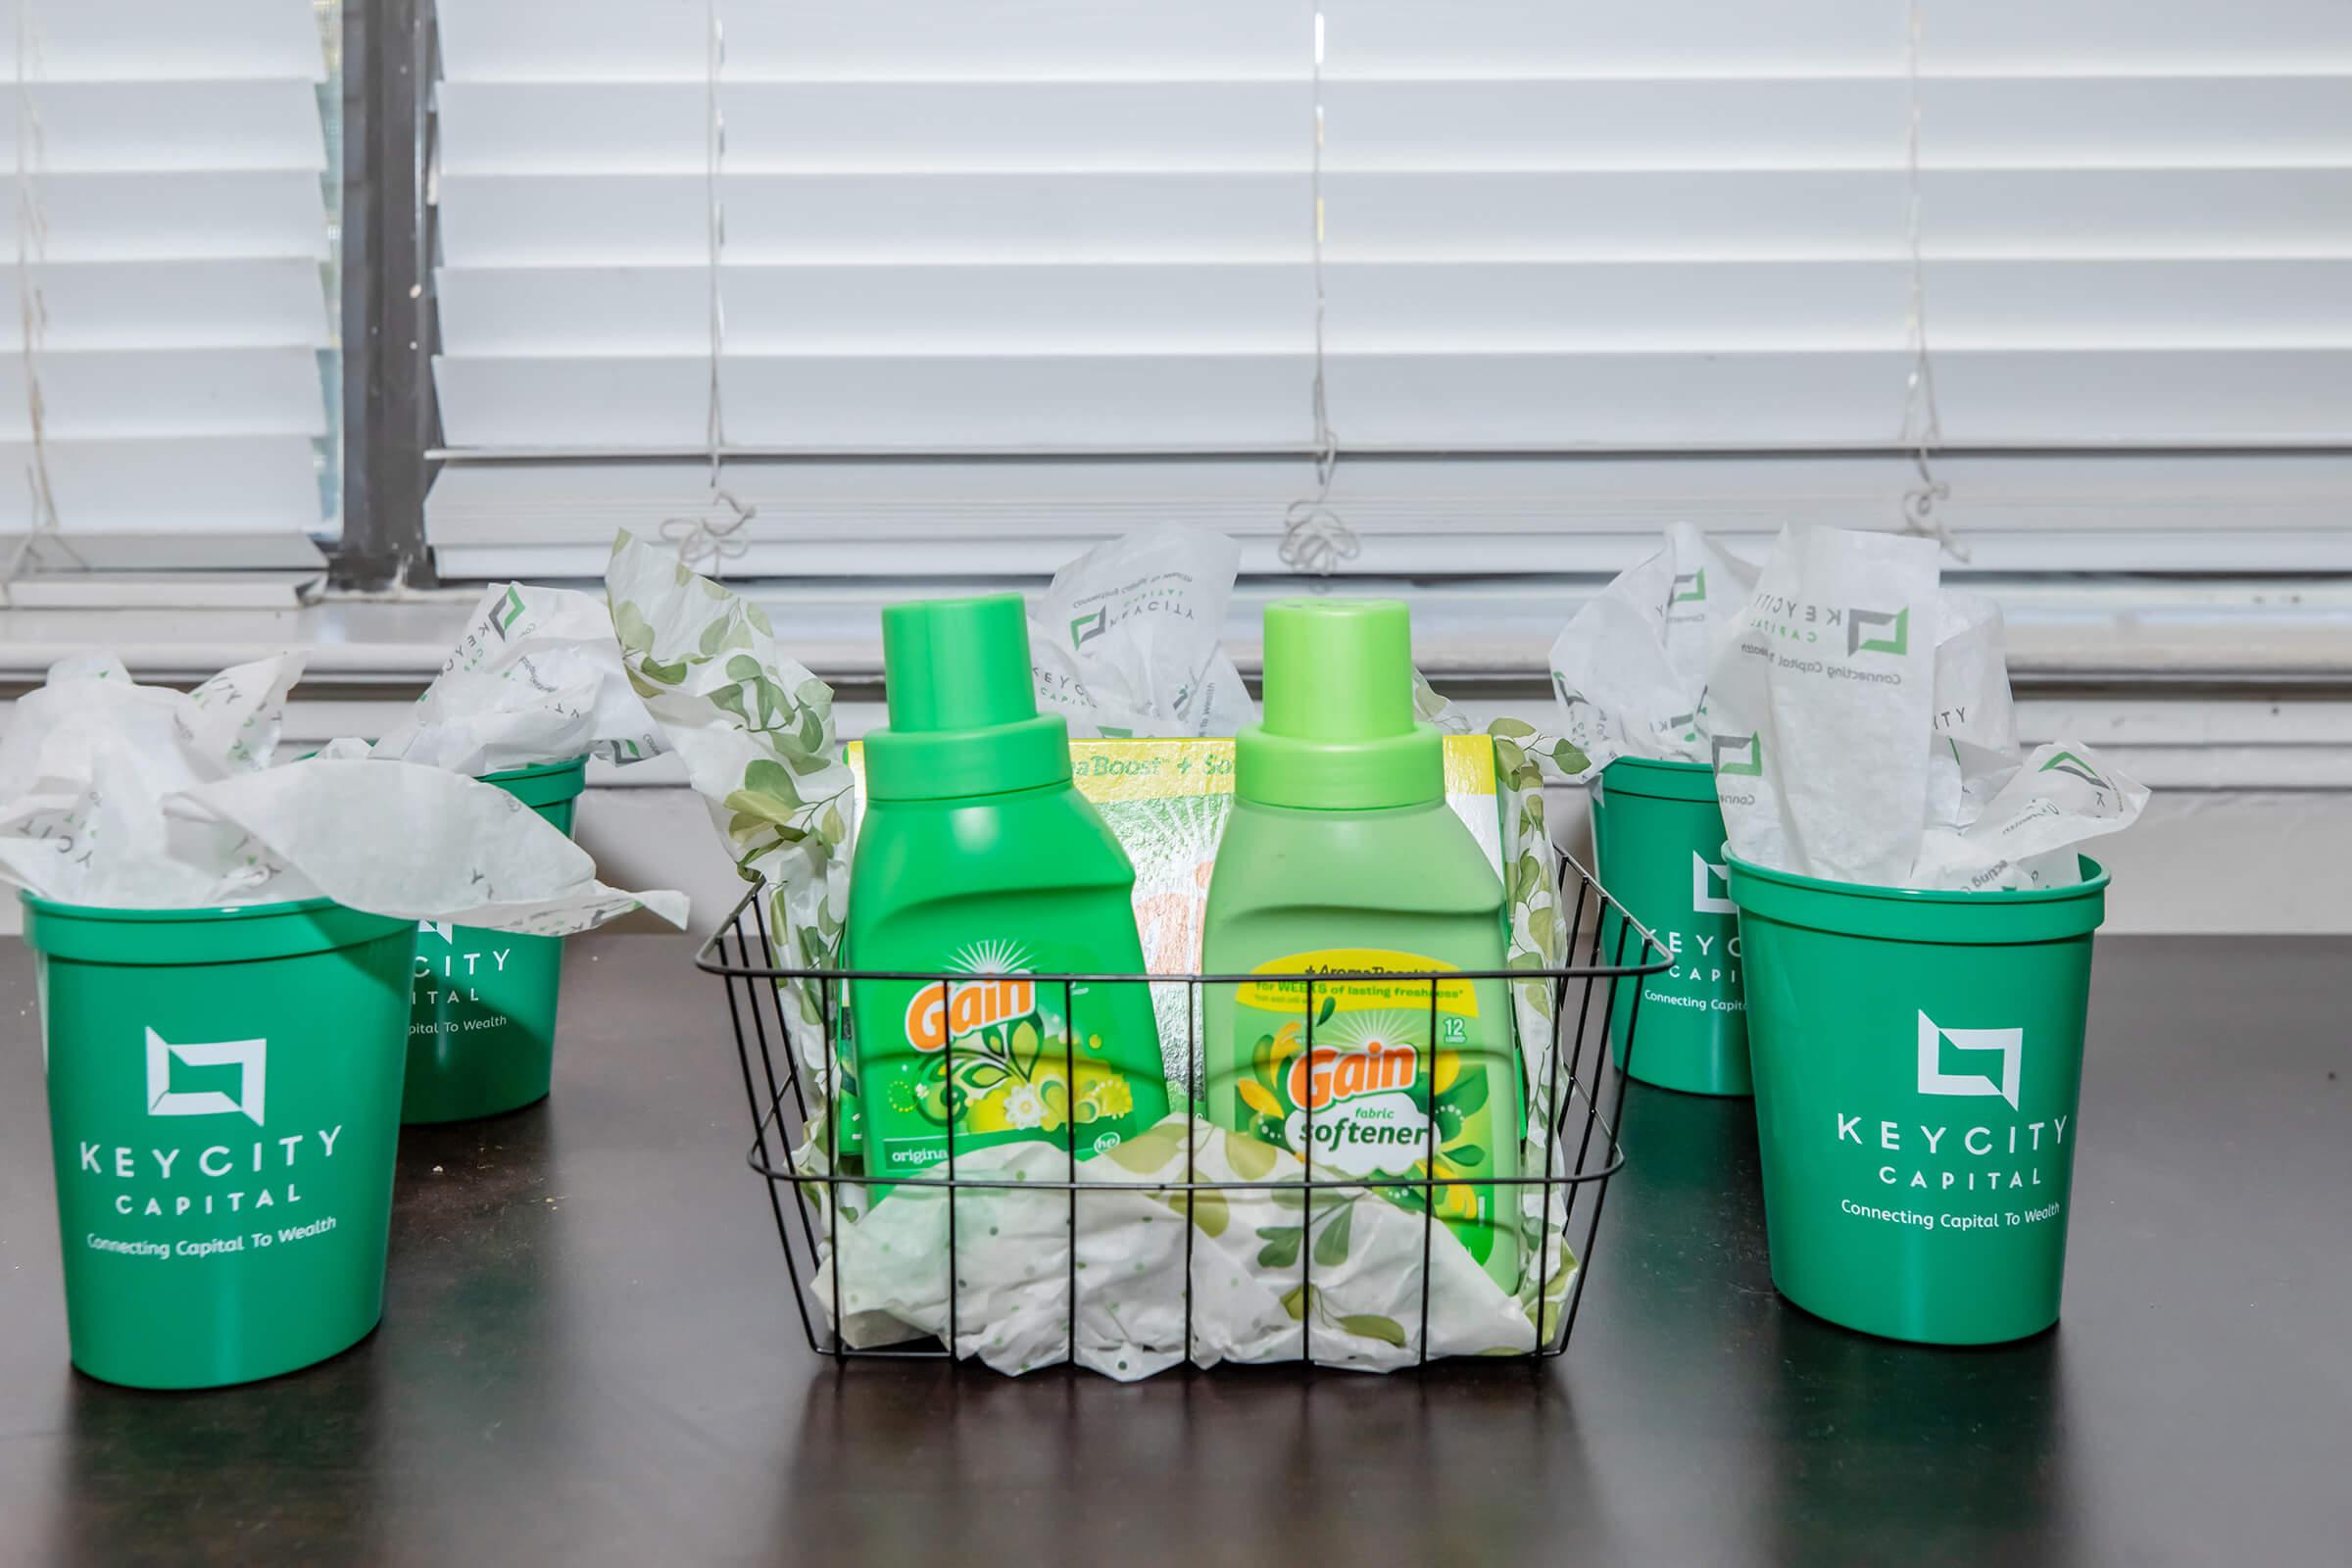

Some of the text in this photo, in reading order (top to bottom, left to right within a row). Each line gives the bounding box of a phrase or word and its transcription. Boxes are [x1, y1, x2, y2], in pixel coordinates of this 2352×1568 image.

[1331, 984, 1345, 995] of
[1348, 986, 1391, 999] lasting
[1644, 989, 1707, 1011] Connecting
[444, 1021, 459, 1032] To
[463, 1014, 508, 1031] Wealth
[905, 969, 1036, 1052] Gain
[1444, 1017, 1465, 1036] 12
[1288, 1041, 1418, 1112] Gain
[1355, 1106, 1396, 1119] fabric
[1838, 1113, 2068, 1155] KEYCITY
[80, 1125, 343, 1179] KEYCITY
[1879, 1166, 2041, 1191] CAPITAL
[115, 1183, 302, 1216] CAPITAL
[1841, 1200, 2061, 1231] Connecting Capital To Wealth
[86, 1216, 337, 1260] Connecting Capital To Wealth
